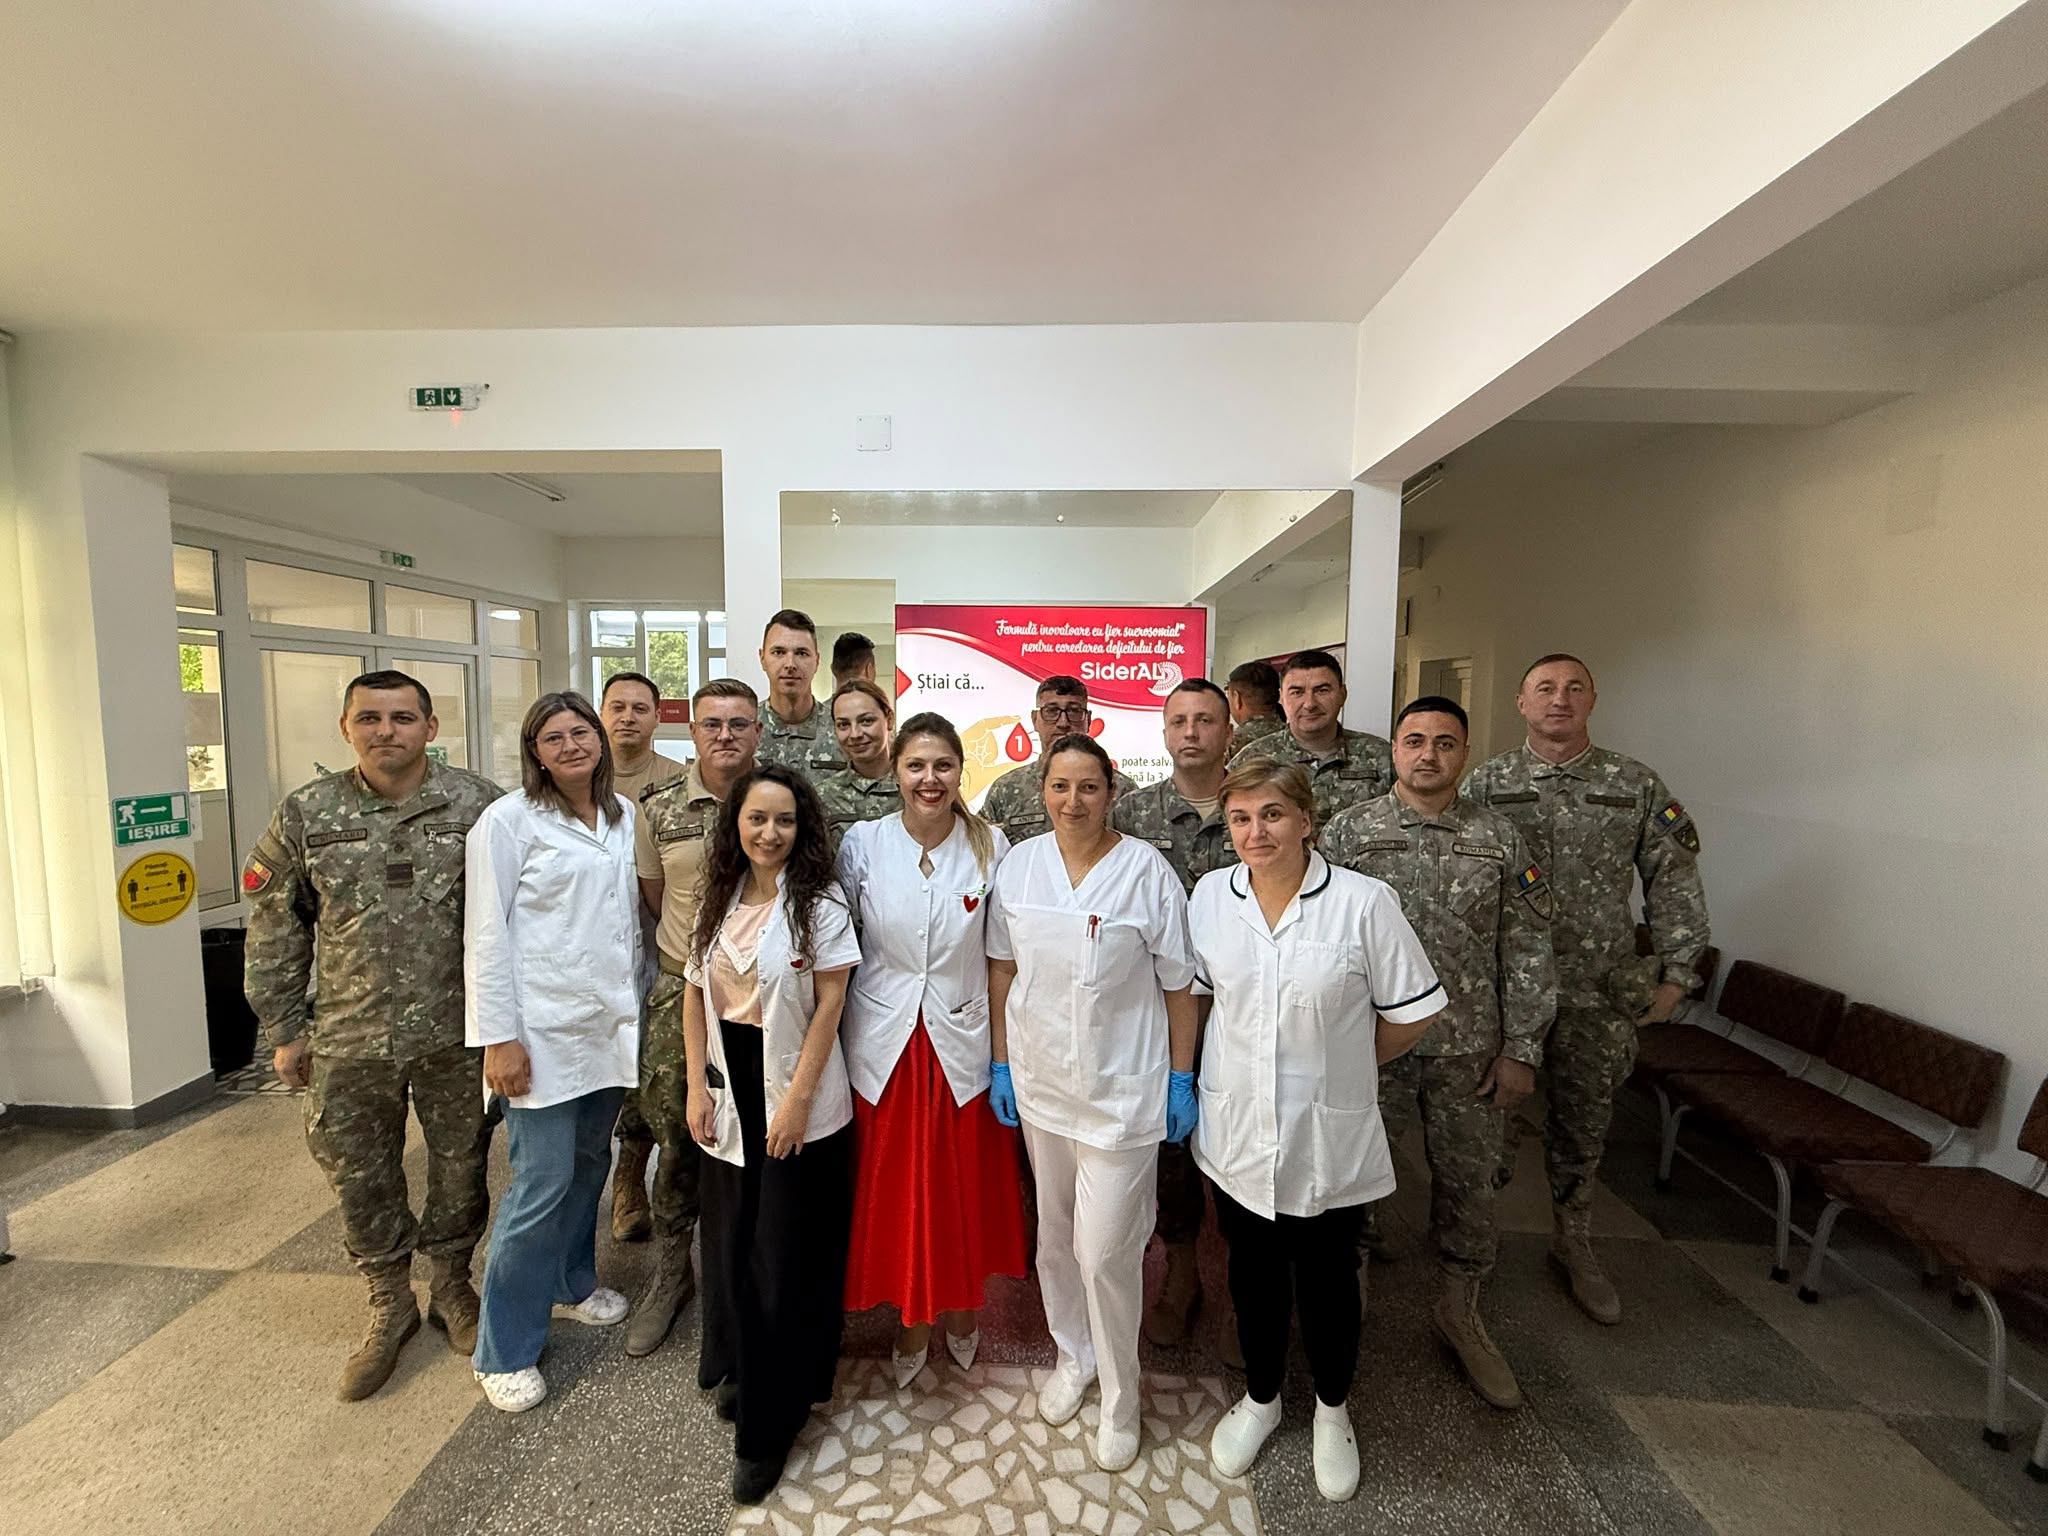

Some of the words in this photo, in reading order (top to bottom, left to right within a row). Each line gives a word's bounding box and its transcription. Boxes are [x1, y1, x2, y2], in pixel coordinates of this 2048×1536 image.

[995, 619, 1038, 636] Formulă
[1039, 622, 1091, 636] inovatoare
[1091, 626, 1104, 637] cu
[1104, 623, 1122, 642] fier
[1021, 639, 1054, 656] pentru
[1055, 639, 1105, 654] corectarea
[1105, 639, 1153, 660] deficitului
[1153, 639, 1167, 655] de
[1166, 640, 1185, 660] fier
[1081, 662, 1165, 680] SiderAL
[917, 673, 950, 695] Știai
[954, 673, 985, 690] că...
[1015, 736, 1023, 752] 1
[1121, 756, 1149, 769] poate
[1147, 771, 1156, 782] la
